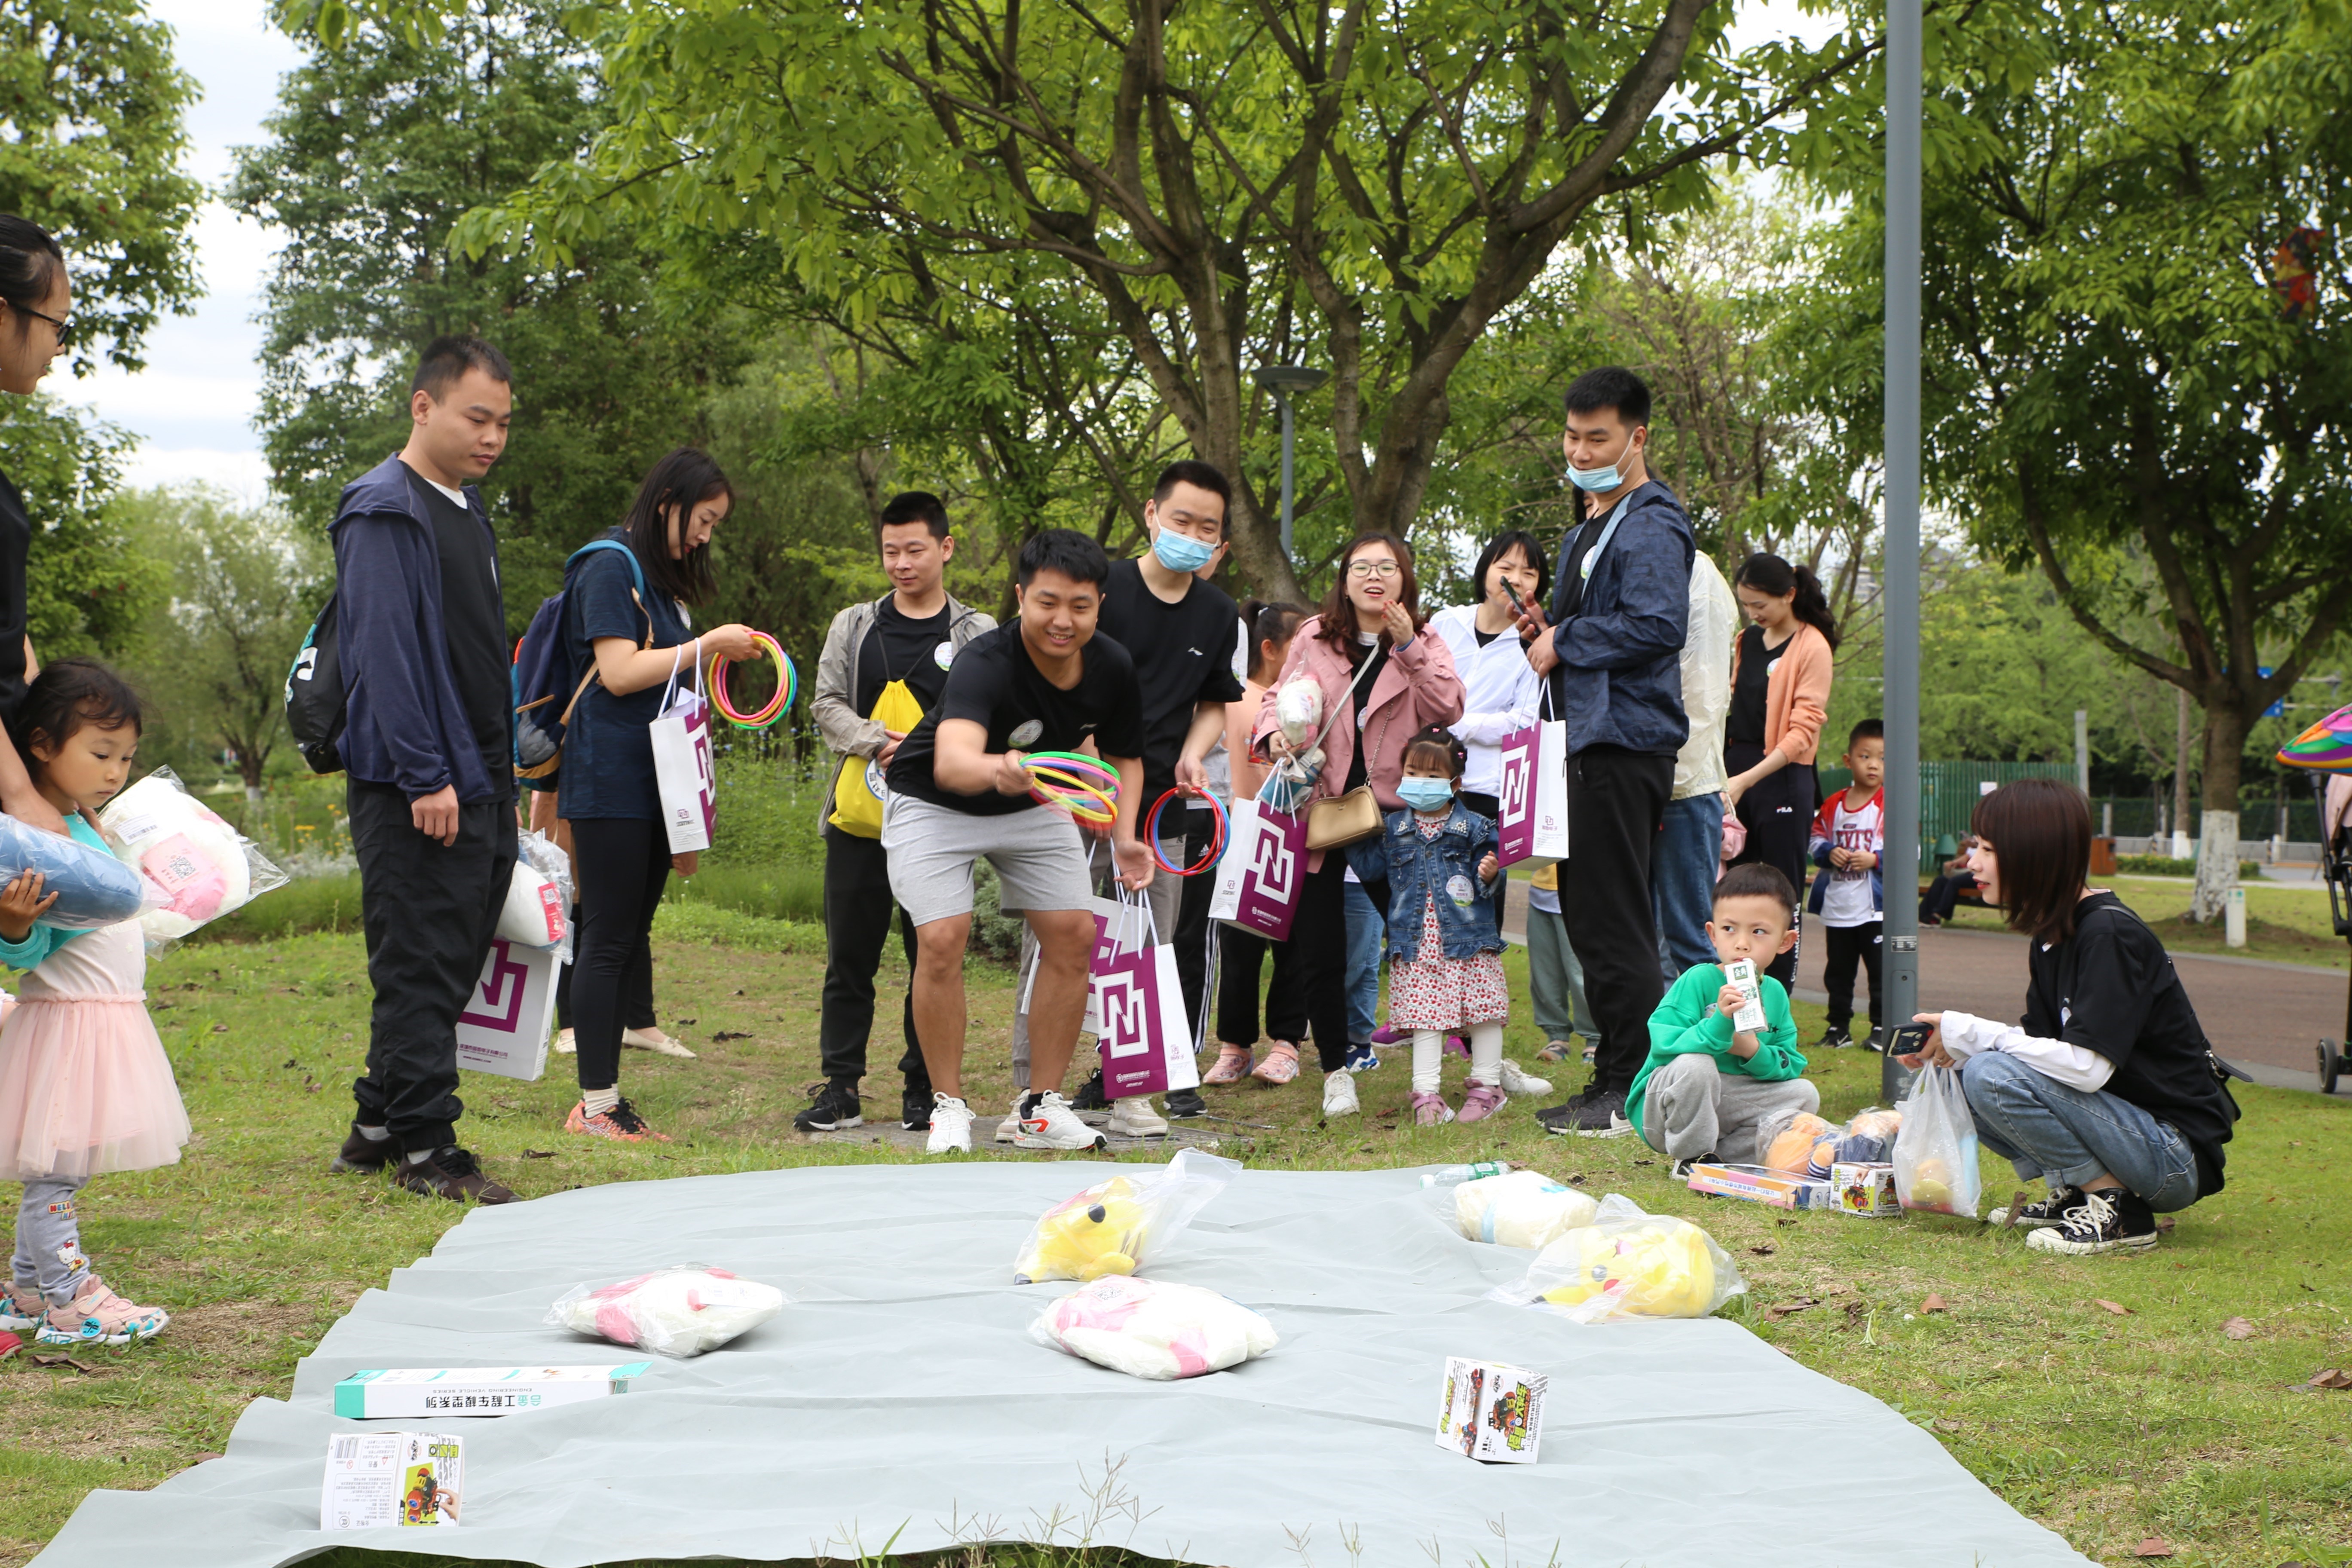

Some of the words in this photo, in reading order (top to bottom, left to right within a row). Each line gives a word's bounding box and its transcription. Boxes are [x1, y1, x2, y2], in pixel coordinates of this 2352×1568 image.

[1793, 902, 1801, 923] FILA
[425, 1394, 542, 1409] 合金工程车模型系列
